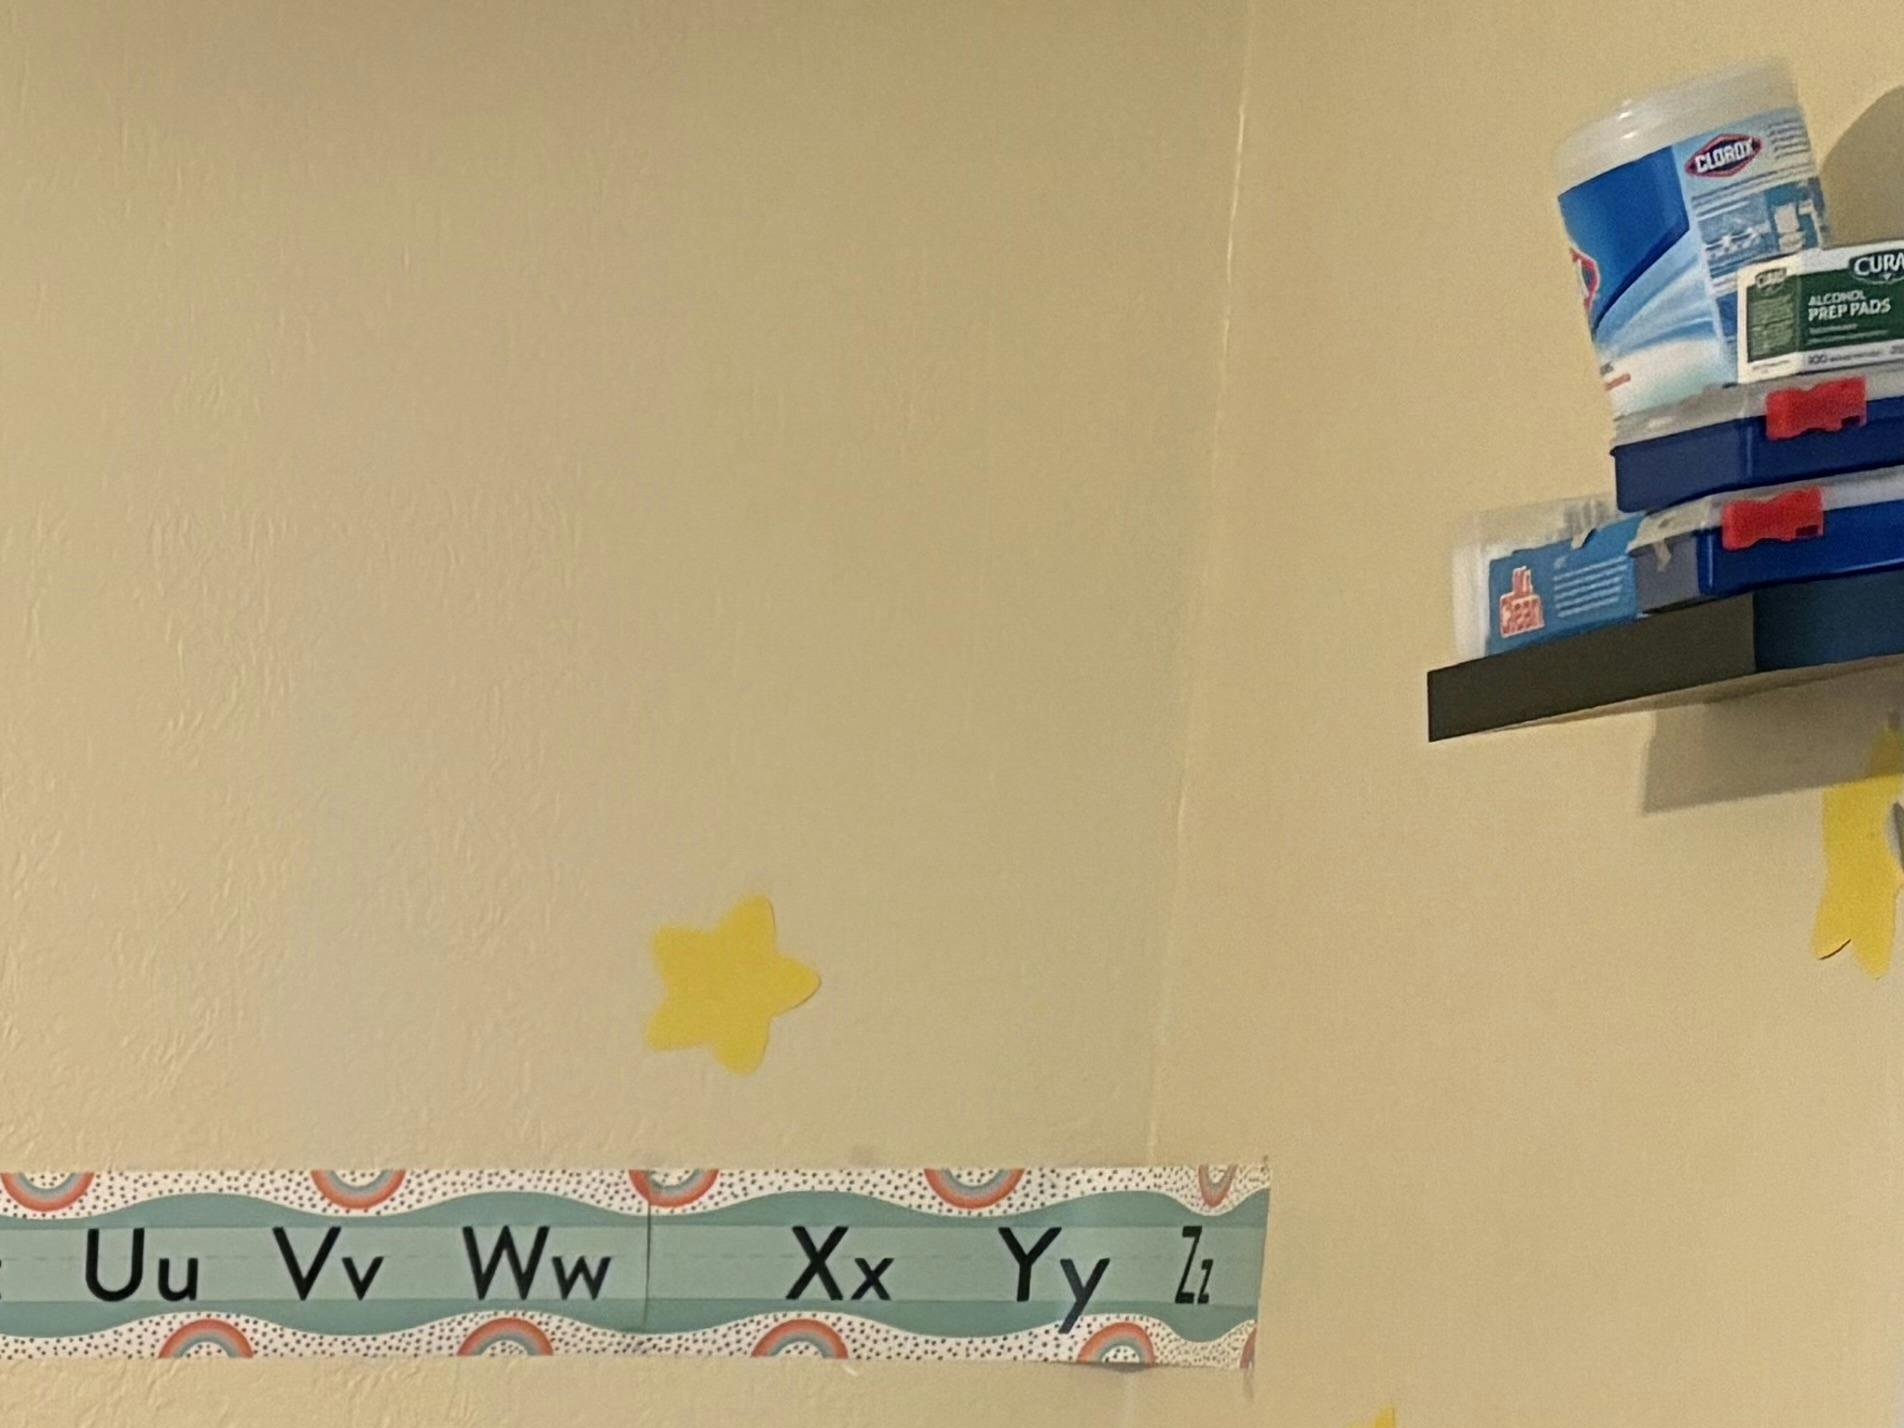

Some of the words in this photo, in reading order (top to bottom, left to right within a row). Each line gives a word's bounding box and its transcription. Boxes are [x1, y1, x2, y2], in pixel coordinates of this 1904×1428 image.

[1694, 138, 1754, 174] CLOROX
[1808, 290, 1865, 306] ALCOHOL
[1808, 306, 1848, 321] PREP
[1850, 298, 1891, 317] PADS
[86, 1228, 198, 1302] Uu
[272, 1226, 384, 1301] Vv
[463, 1225, 611, 1300] Ww
[786, 1226, 893, 1300] Xx
[998, 1227, 1110, 1333] Yy
[1175, 1225, 1213, 1304] Zz
